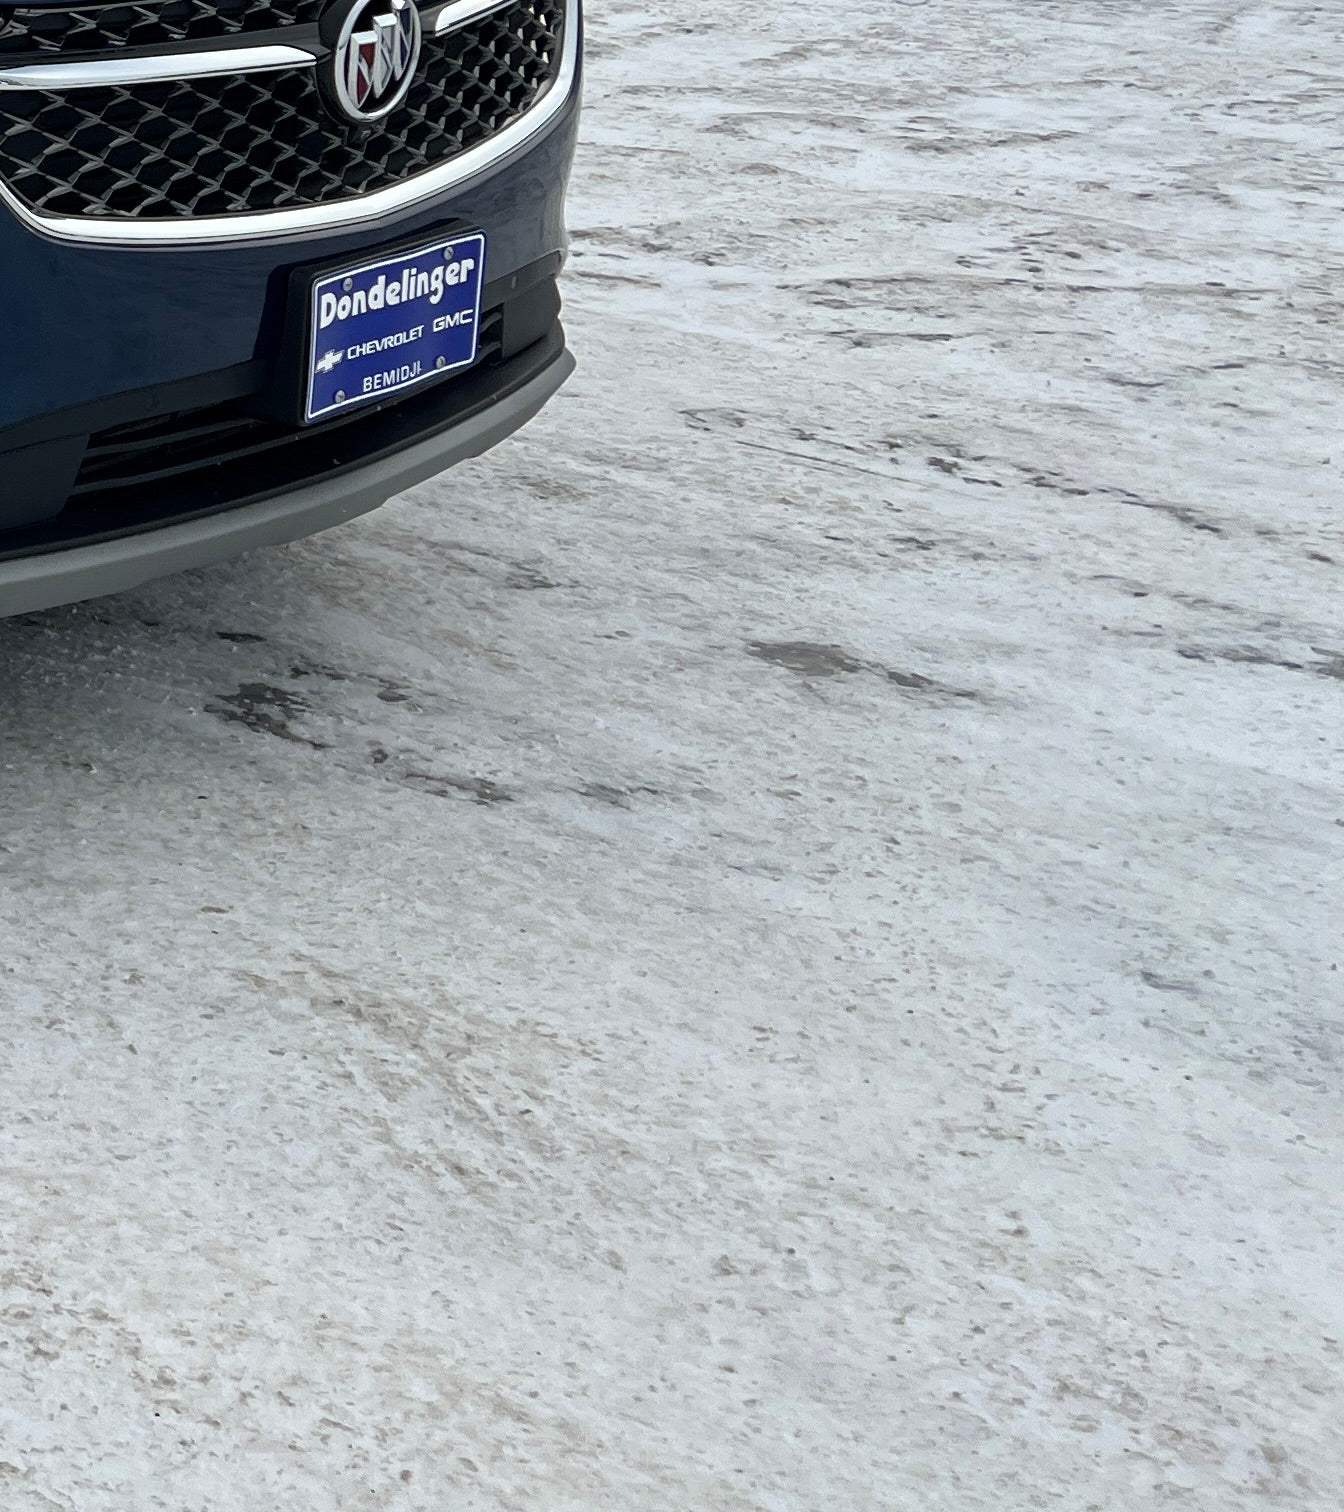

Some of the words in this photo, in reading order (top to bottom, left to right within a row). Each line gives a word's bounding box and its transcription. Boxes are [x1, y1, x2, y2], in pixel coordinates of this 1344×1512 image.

[319, 257, 475, 330] Dondelinger
[346, 324, 425, 360] CHEVROLET
[432, 308, 474, 333] GMC
[362, 360, 422, 393] BEMIDJI
